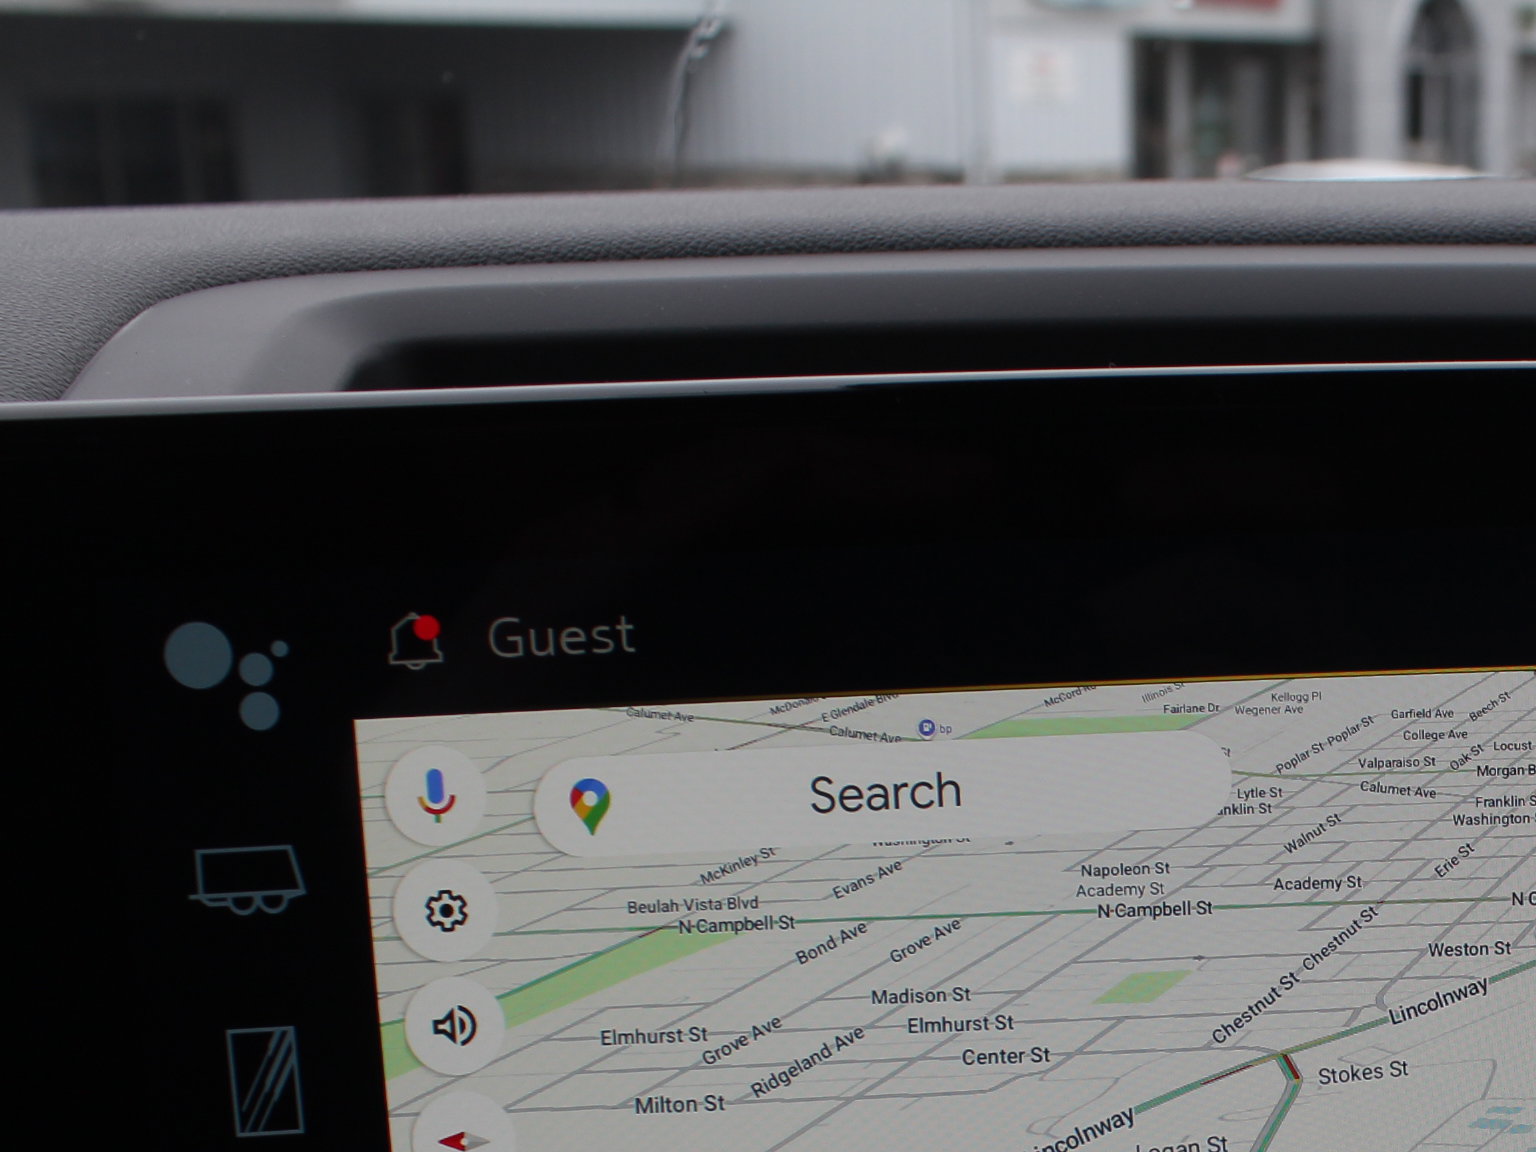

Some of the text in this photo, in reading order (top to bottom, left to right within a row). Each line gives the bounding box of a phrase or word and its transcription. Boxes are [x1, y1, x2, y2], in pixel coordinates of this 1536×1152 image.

[489, 615, 636, 658] Guest
[1163, 703, 1219, 714] Fairlane Dr
[1391, 708, 1454, 719] Garfield Ave
[1403, 729, 1468, 741] College Ave
[1493, 741, 1532, 751] Locust
[1276, 741, 1324, 775] Poplar St
[1359, 756, 1436, 770] Valparaiso St
[1477, 765, 1524, 778] Morgan
[811, 771, 962, 814] Search
[1360, 781, 1436, 798] Calumet Ave
[1475, 796, 1525, 807] Franklin
[1453, 813, 1530, 829] Washington
[1284, 813, 1342, 854] Walnut St
[700, 847, 776, 885] McKinley St
[1434, 842, 1475, 878] Erie St
[1081, 861, 1170, 879] Napoleon St
[832, 860, 903, 900] Evans Ave
[1076, 881, 1165, 900] Academy St
[1512, 892, 1524, 906] N
[627, 896, 759, 914] Beulah Vista Blvd
[679, 915, 796, 936] N Campbell St
[795, 920, 869, 966] Bond Ave
[1428, 941, 1512, 958] Weston St
[871, 986, 971, 1005] Madison St
[1389, 977, 1489, 1025] Lincolnway
[1212, 970, 1300, 1045] Chestnut St
[908, 1014, 1014, 1034] Elmhurst St
[702, 1016, 783, 1066] Grove Ave
[750, 1025, 866, 1099] Ridgeland Ave
[962, 1047, 1051, 1066] Center St
[1318, 1061, 1409, 1085] Stokes St
[635, 1094, 726, 1115] Milton St
